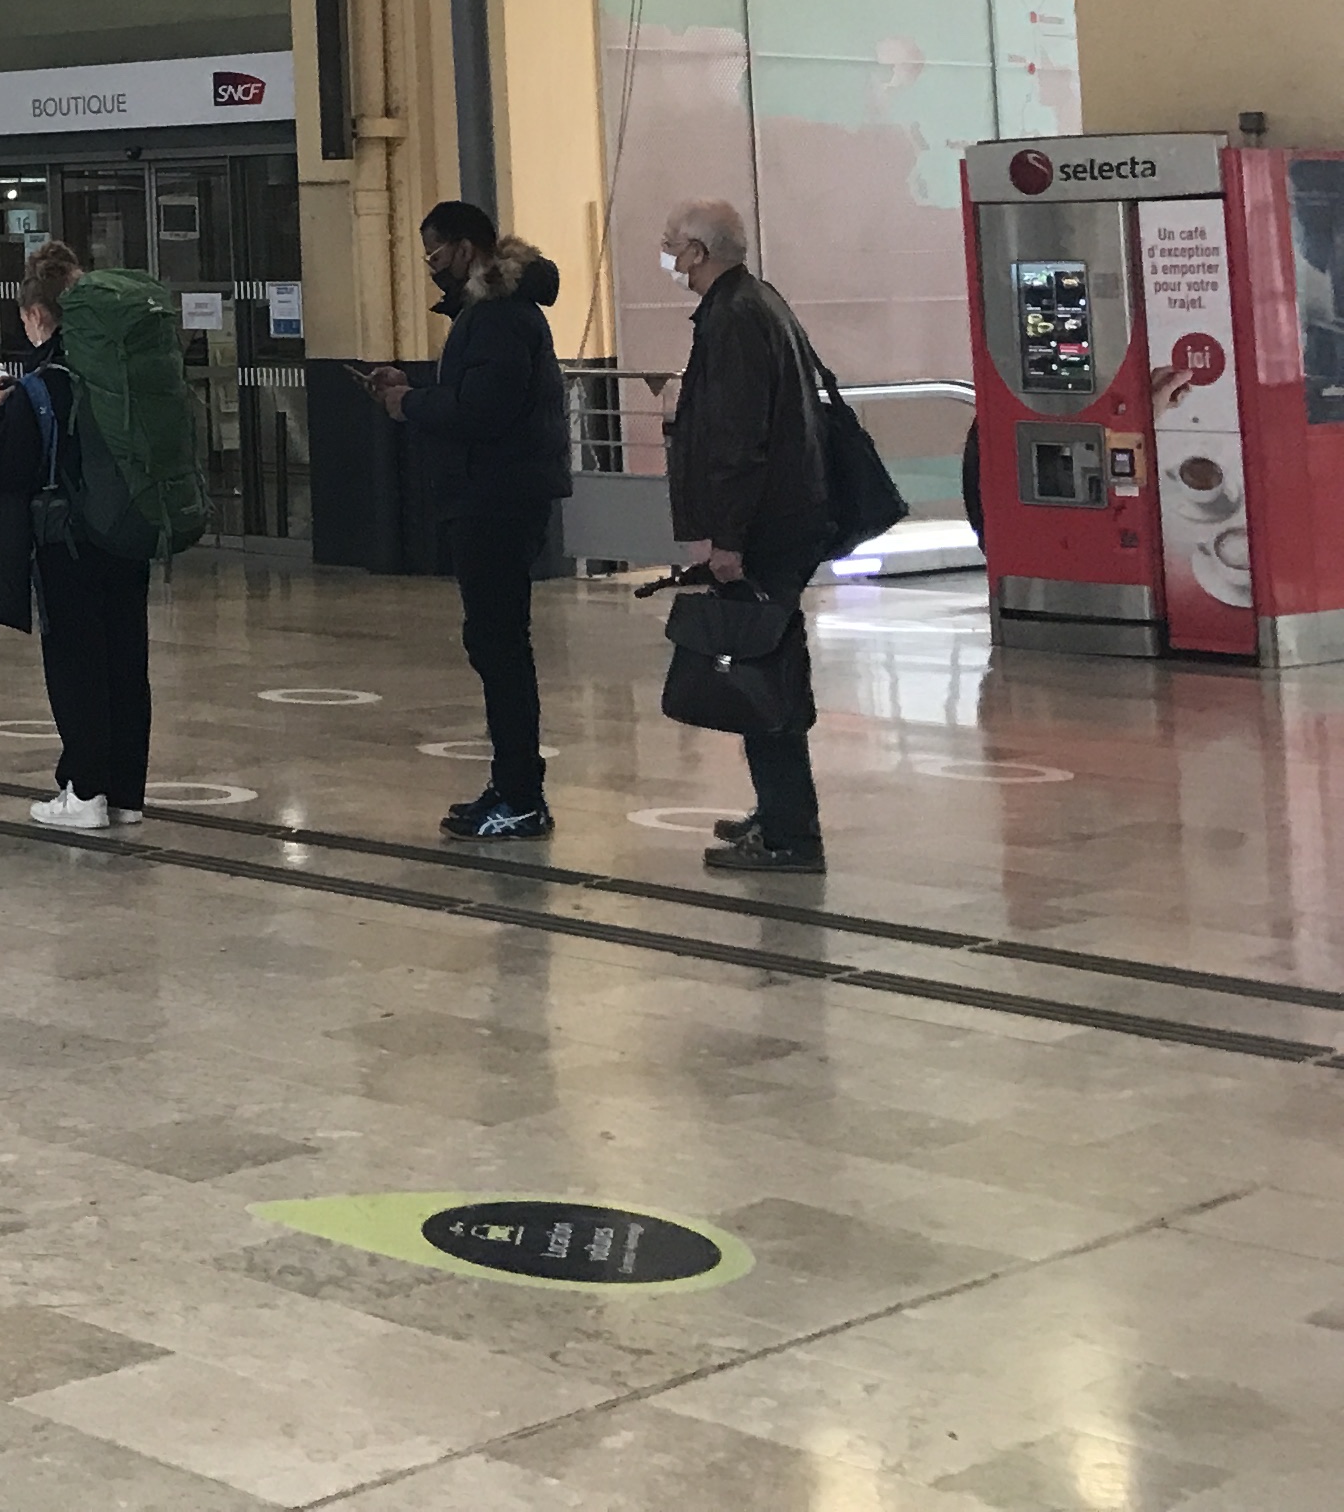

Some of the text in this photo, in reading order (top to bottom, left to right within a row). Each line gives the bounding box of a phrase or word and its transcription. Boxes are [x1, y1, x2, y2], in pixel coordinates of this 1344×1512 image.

[216, 83, 263, 103] SNCF
[31, 93, 128, 117] BOUTIQUE
[1059, 156, 1157, 182] selecta
[15, 216, 31, 231] 16
[1157, 226, 1207, 241] Un café
[1147, 244, 1221, 261] d'exception
[1150, 262, 1220, 278] à emporter
[1154, 279, 1219, 295] pour votre
[1187, 345, 1211, 369] ici
